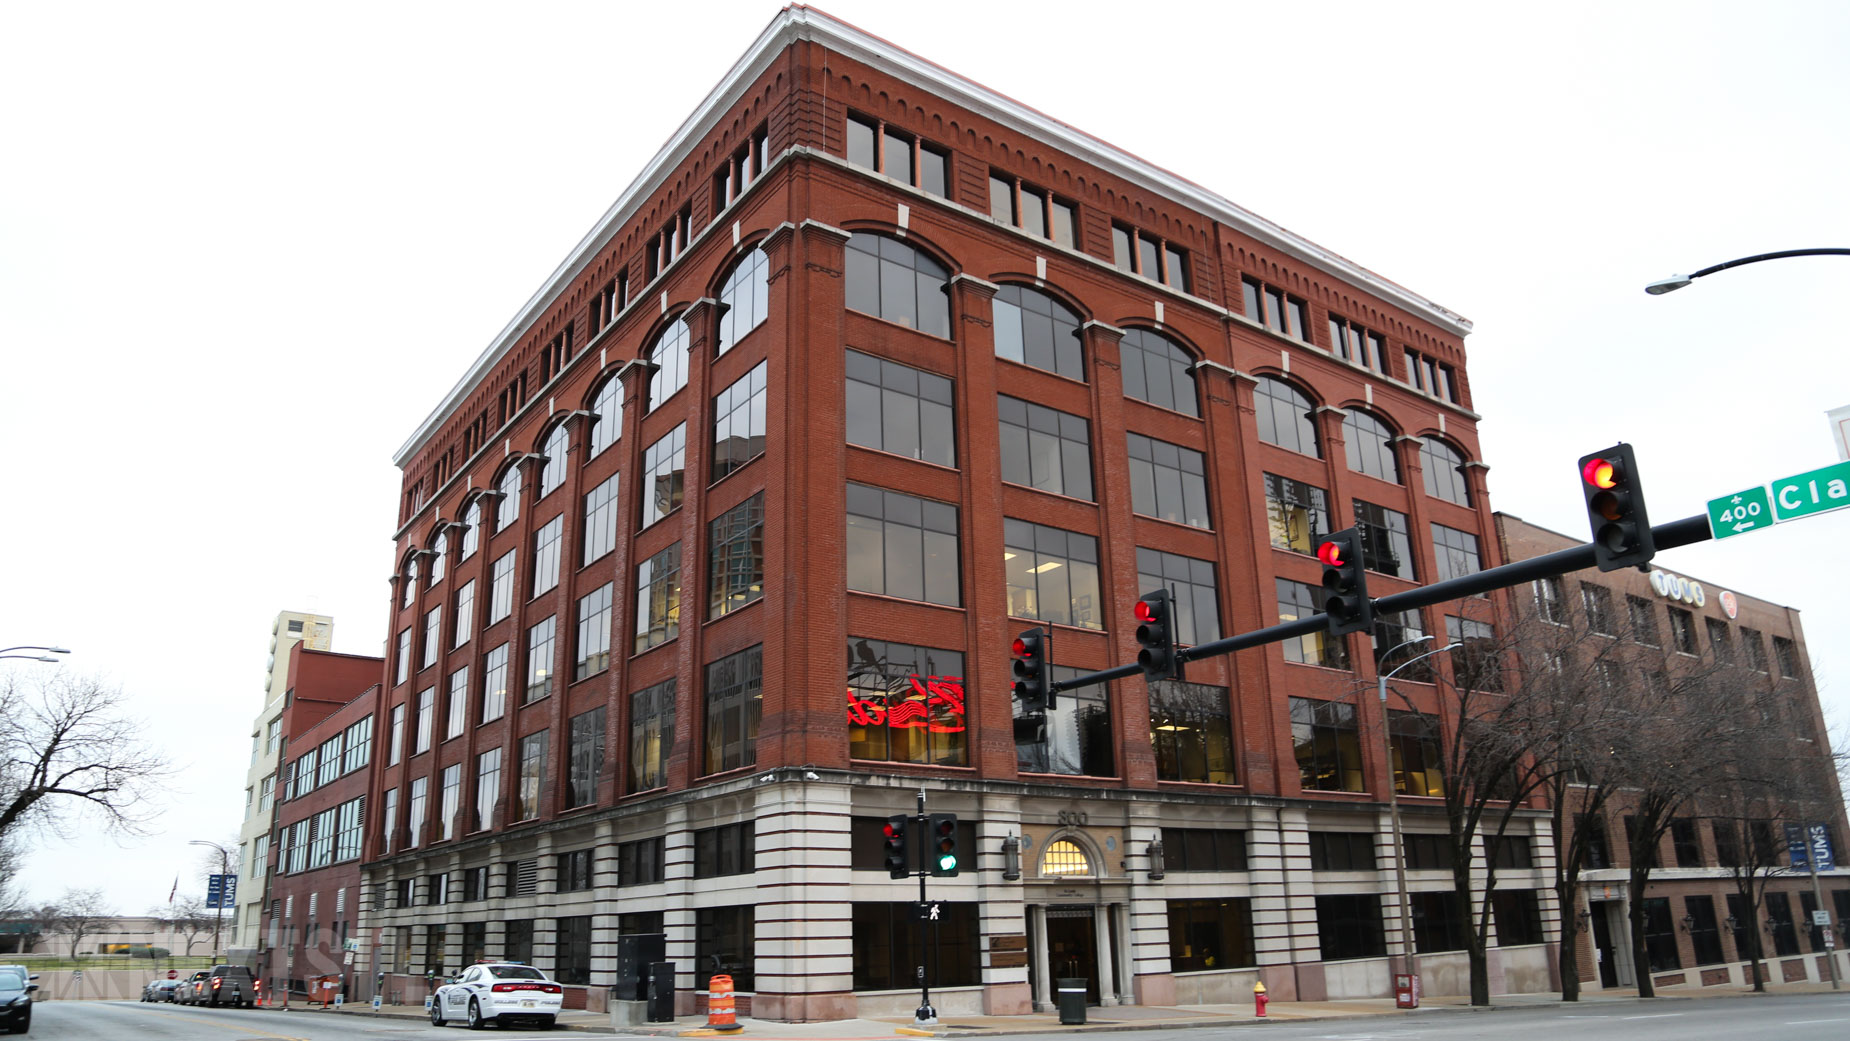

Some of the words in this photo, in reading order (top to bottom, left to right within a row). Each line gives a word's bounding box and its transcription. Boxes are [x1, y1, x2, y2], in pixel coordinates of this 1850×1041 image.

[1778, 478, 1848, 510] Cla
[1719, 502, 1761, 523] 400
[1655, 573, 1704, 604] TUMS
[1810, 826, 1831, 868] TUMS
[224, 877, 236, 907] TUMS
